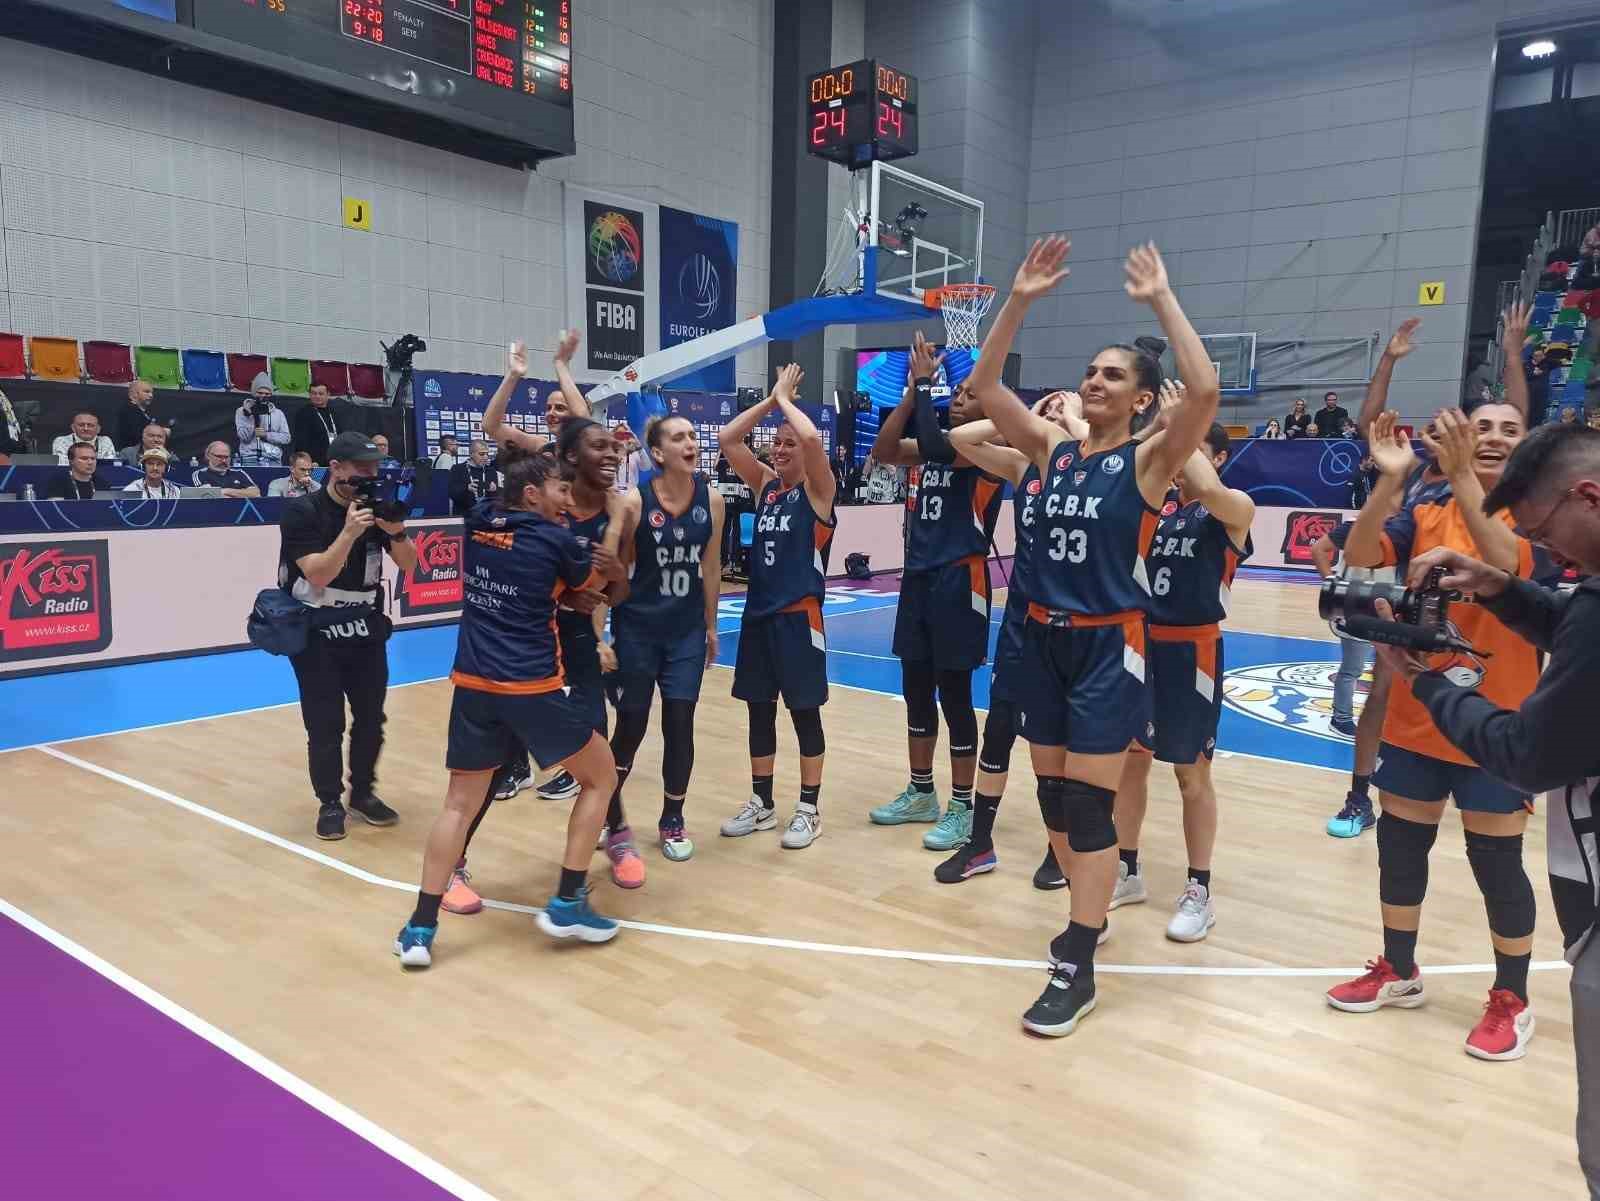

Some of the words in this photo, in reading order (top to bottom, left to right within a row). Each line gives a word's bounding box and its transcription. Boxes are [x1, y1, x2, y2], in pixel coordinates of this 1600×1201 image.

[345, 0, 382, 24] 22:20
[525, 19, 535, 31] 12
[523, 80, 536, 94] 33
[813, 109, 845, 144] 24
[878, 102, 903, 138] 24
[353, 205, 362, 222] J
[1426, 287, 1437, 301] V
[596, 301, 636, 331] FIBA
[921, 495, 943, 520] 13
[1045, 494, 1103, 520] Ç.B.K
[764, 541, 775, 566] 5
[1049, 527, 1087, 564] 33
[0, 548, 90, 609] Kiss
[432, 567, 457, 580] Radio
[659, 569, 690, 597] 10
[1153, 566, 1171, 596] 6
[44, 597, 88, 614] Radio
[25, 623, 90, 637] www.kiss.cz
